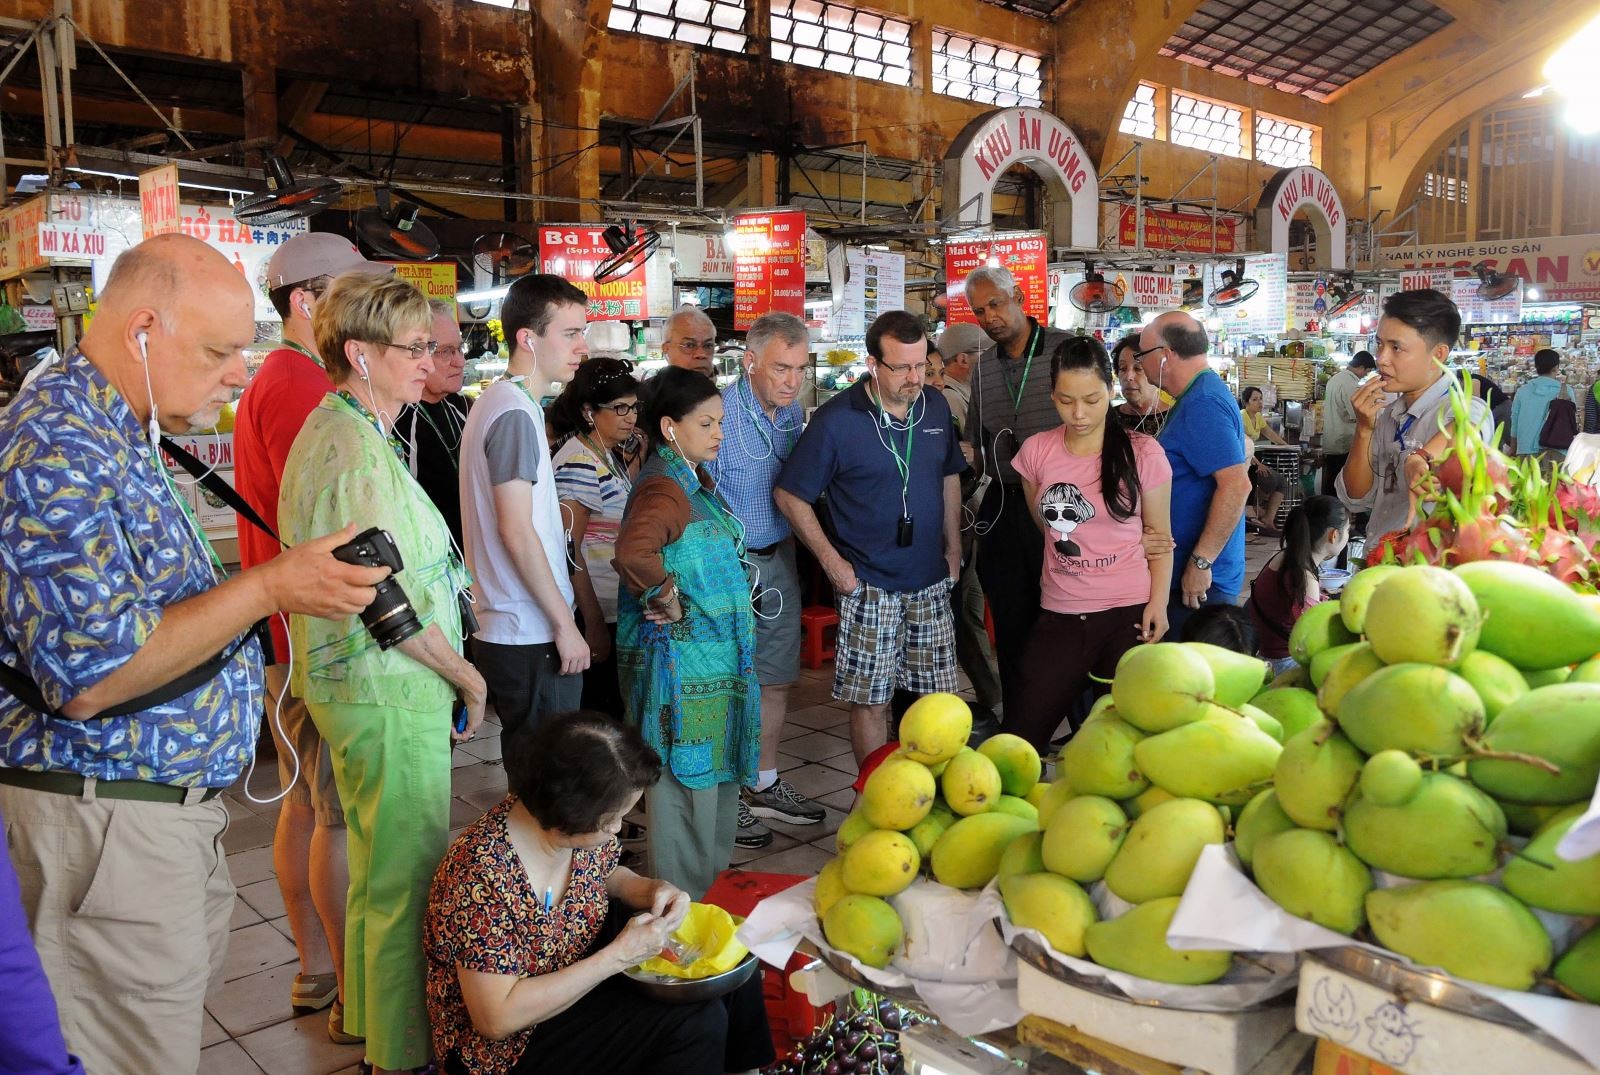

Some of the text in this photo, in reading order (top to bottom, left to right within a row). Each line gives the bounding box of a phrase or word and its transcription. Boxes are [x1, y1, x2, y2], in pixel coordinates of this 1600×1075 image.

[975, 112, 1087, 193] KHU ĂN UỐNG
[1278, 179, 1298, 221] KHU
[43, 225, 58, 251] MÌ
[62, 227, 80, 253] XÁ
[83, 229, 104, 255] XÍU
[545, 231, 579, 245] Bà
[948, 246, 967, 256] Mai
[1437, 245, 1475, 259] NGHỆ
[1478, 243, 1508, 255] SÚC
[702, 259, 719, 273] BÚN
[953, 259, 980, 268] SINH
[600, 281, 643, 297] NOODLES
